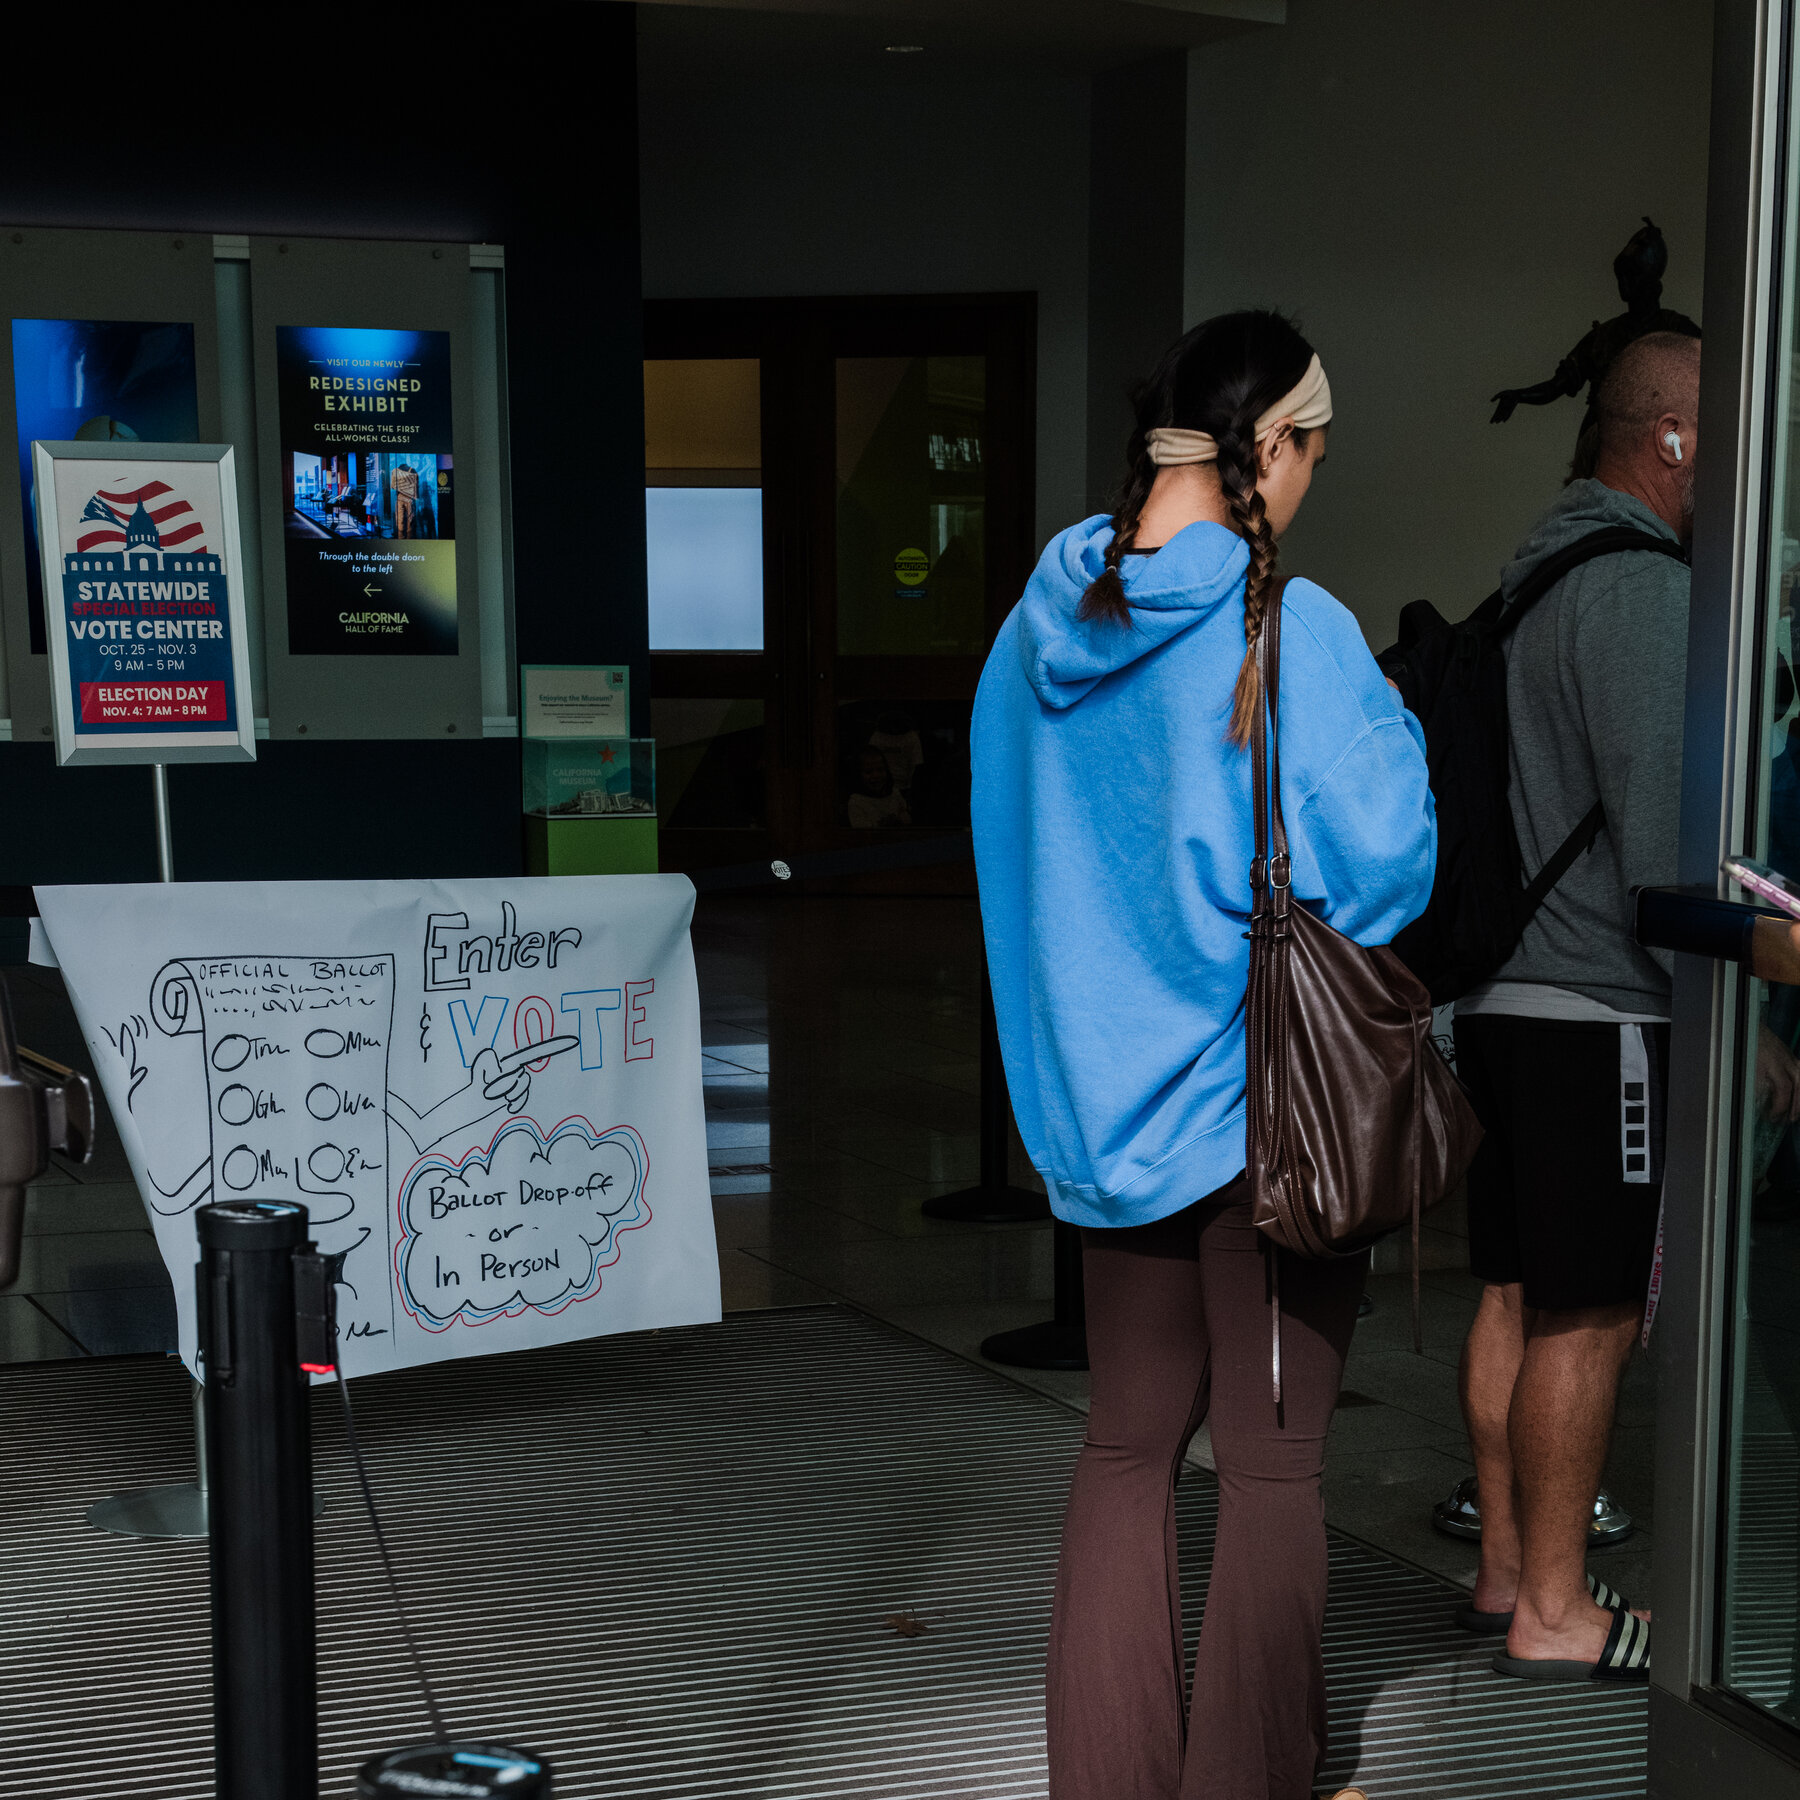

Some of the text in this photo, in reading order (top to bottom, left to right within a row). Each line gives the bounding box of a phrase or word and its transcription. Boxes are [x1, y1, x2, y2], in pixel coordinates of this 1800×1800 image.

[327, 359, 404, 368] VISIT OUR NEWLY
[310, 376, 421, 393] REDESIGNED
[324, 395, 409, 413] EXHIBIT
[314, 423, 420, 433] CELEBRATING THE FIRST
[325, 434, 410, 443] ALL-WOMEN CLASS!
[318, 551, 425, 563] Through the double doors
[352, 564, 393, 575] to the left
[78, 581, 210, 601] STATEWIDE
[72, 602, 216, 616] SPECIAL ELECTION
[338, 612, 409, 624] CALIFORNIA
[70, 620, 224, 640] VOTE CENTER
[345, 625, 404, 634] HALL OF FAME
[99, 644, 128, 656] OCT.
[131, 644, 145, 656] 25
[158, 644, 187, 655] NOV.
[190, 644, 196, 655] 3
[114, 660, 122, 671] 9
[126, 660, 144, 671] AM
[156, 660, 164, 671] 5
[168, 660, 184, 670] PM
[98, 687, 208, 702] ELECTION DAY
[539, 694, 568, 703] Enjoying
[102, 706, 130, 717] NOV.
[132, 706, 143, 716] 4:
[146, 706, 152, 716] 7
[154, 706, 172, 715] AM
[182, 706, 188, 715] 8
[191, 706, 207, 715] PM
[424, 900, 582, 992] Enter
[200, 962, 387, 980] OFFICIAL BALLOT
[448, 978, 655, 1073] VOTE
[488, 1224, 524, 1242] or
[436, 1256, 460, 1288] In
[1646, 1262, 1662, 1323] LMU LIONS
